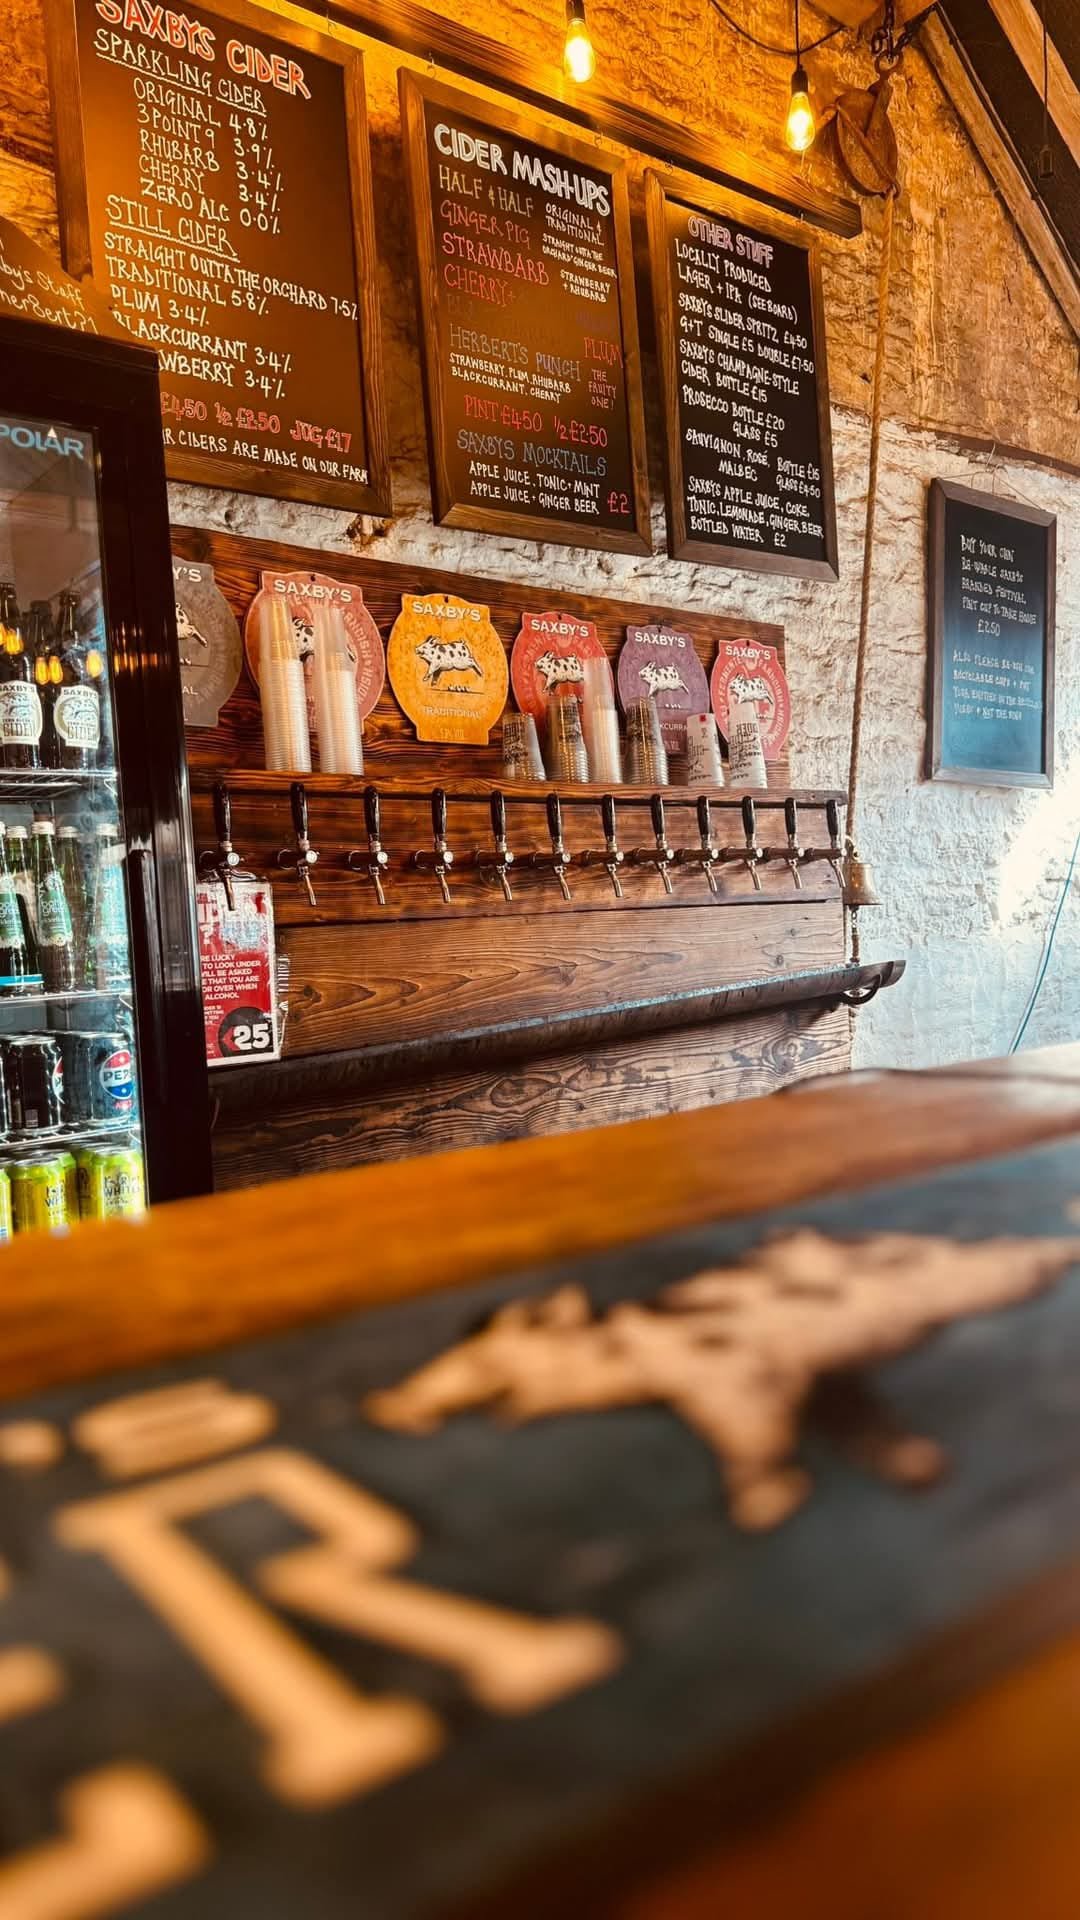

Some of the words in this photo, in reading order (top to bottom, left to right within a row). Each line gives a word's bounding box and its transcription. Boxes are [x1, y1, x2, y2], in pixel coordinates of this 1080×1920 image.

[96, 0, 216, 61] SAXBYS
[226, 40, 312, 100] CIDER
[93, 28, 213, 97] SPARKLING
[218, 79, 267, 113] CIDER
[134, 78, 221, 126] ORIGINAL
[140, 129, 220, 172] RHUBARB
[138, 154, 205, 195] CHERRY
[434, 123, 508, 176] CIDER
[512, 151, 611, 217] MASH-UPS
[140, 177, 193, 210] ZERO
[199, 196, 230, 222] ALC
[438, 164, 482, 200] HALF
[498, 186, 534, 219] HALF
[105, 194, 170, 236] STILL
[178, 217, 237, 256] CIDER
[440, 199, 504, 238] GINGER
[505, 220, 531, 250] PIG
[545, 203, 594, 230] ORIGINAL
[545, 215, 605, 247] TRADITIONAL
[688, 215, 734, 252] OTHER
[735, 233, 774, 269] STUFF
[104, 232, 186, 271] STRAIGHT
[234, 268, 261, 291] THE
[263, 275, 328, 311] ORCHARD
[442, 232, 550, 286] STRAWBARB
[674, 238, 720, 274] LOCALLY
[723, 259, 772, 293] PRODUCED
[36, 271, 85, 312] Staff
[104, 254, 226, 307] TRADITIONAL
[560, 269, 611, 294] STRAWBERRY
[570, 284, 607, 303] RHUBARB
[677, 262, 714, 294] LAGER
[725, 282, 742, 304] IPA
[678, 292, 712, 319] SAXBYS
[714, 306, 745, 331] SLIDER
[746, 317, 779, 344] SPRITZ
[584, 336, 623, 368] PLUM
[679, 339, 715, 365] SAXBYS
[680, 315, 703, 337] G+T
[708, 325, 740, 350] SINGLE
[742, 338, 755, 353] £5
[757, 343, 790, 369] DOUBLE
[536, 351, 581, 382] PUNCH
[592, 369, 607, 382] THE
[681, 360, 711, 387] CIDER
[715, 372, 750, 396] BOTTLE
[751, 385, 768, 403] £15
[530, 387, 561, 404] CHERRY
[588, 381, 616, 399] FRUITY
[464, 394, 499, 423] PINT
[682, 384, 729, 413] PROSECCO
[731, 401, 765, 426] BOTTLE
[765, 413, 785, 431] £20
[290, 420, 323, 448] JUG
[325, 428, 352, 453] £17
[732, 421, 761, 442] GLASS
[764, 431, 779, 448] £5
[179, 430, 228, 452] CIDERS
[232, 439, 259, 460] ARE
[263, 447, 299, 468] MADE
[302, 455, 317, 473] ON
[320, 462, 341, 477] OUR
[342, 464, 369, 485] FARM
[457, 428, 516, 461] SAXBYS
[522, 441, 607, 477] MOCKTAILS
[777, 457, 806, 478] BOTTLE
[469, 460, 500, 479] APPLE
[573, 482, 600, 499] MINT
[688, 476, 721, 497] SAXBYS
[724, 486, 753, 505] APPLE
[718, 460, 758, 482] MALBEC
[776, 475, 798, 491] GLASS
[470, 481, 501, 499] APPLE
[503, 487, 530, 505] JUICE
[538, 492, 572, 512] GINGER
[574, 499, 600, 516] BEER
[607, 490, 631, 514] £2
[690, 516, 729, 535] BOTTLED
[731, 523, 764, 543] WATER
[773, 532, 787, 548] £2
[769, 514, 801, 534] GINGER
[801, 522, 824, 539] BEER
[273, 578, 353, 603] SAXBY'S
[412, 601, 481, 621] SAXBY'S
[531, 619, 589, 637] SAXBY'S
[634, 631, 686, 648] SAXBY'S
[725, 645, 771, 660] SAXBY'S
[423, 706, 481, 719] TRADITIONAL
[233, 1023, 270, 1051] 25
